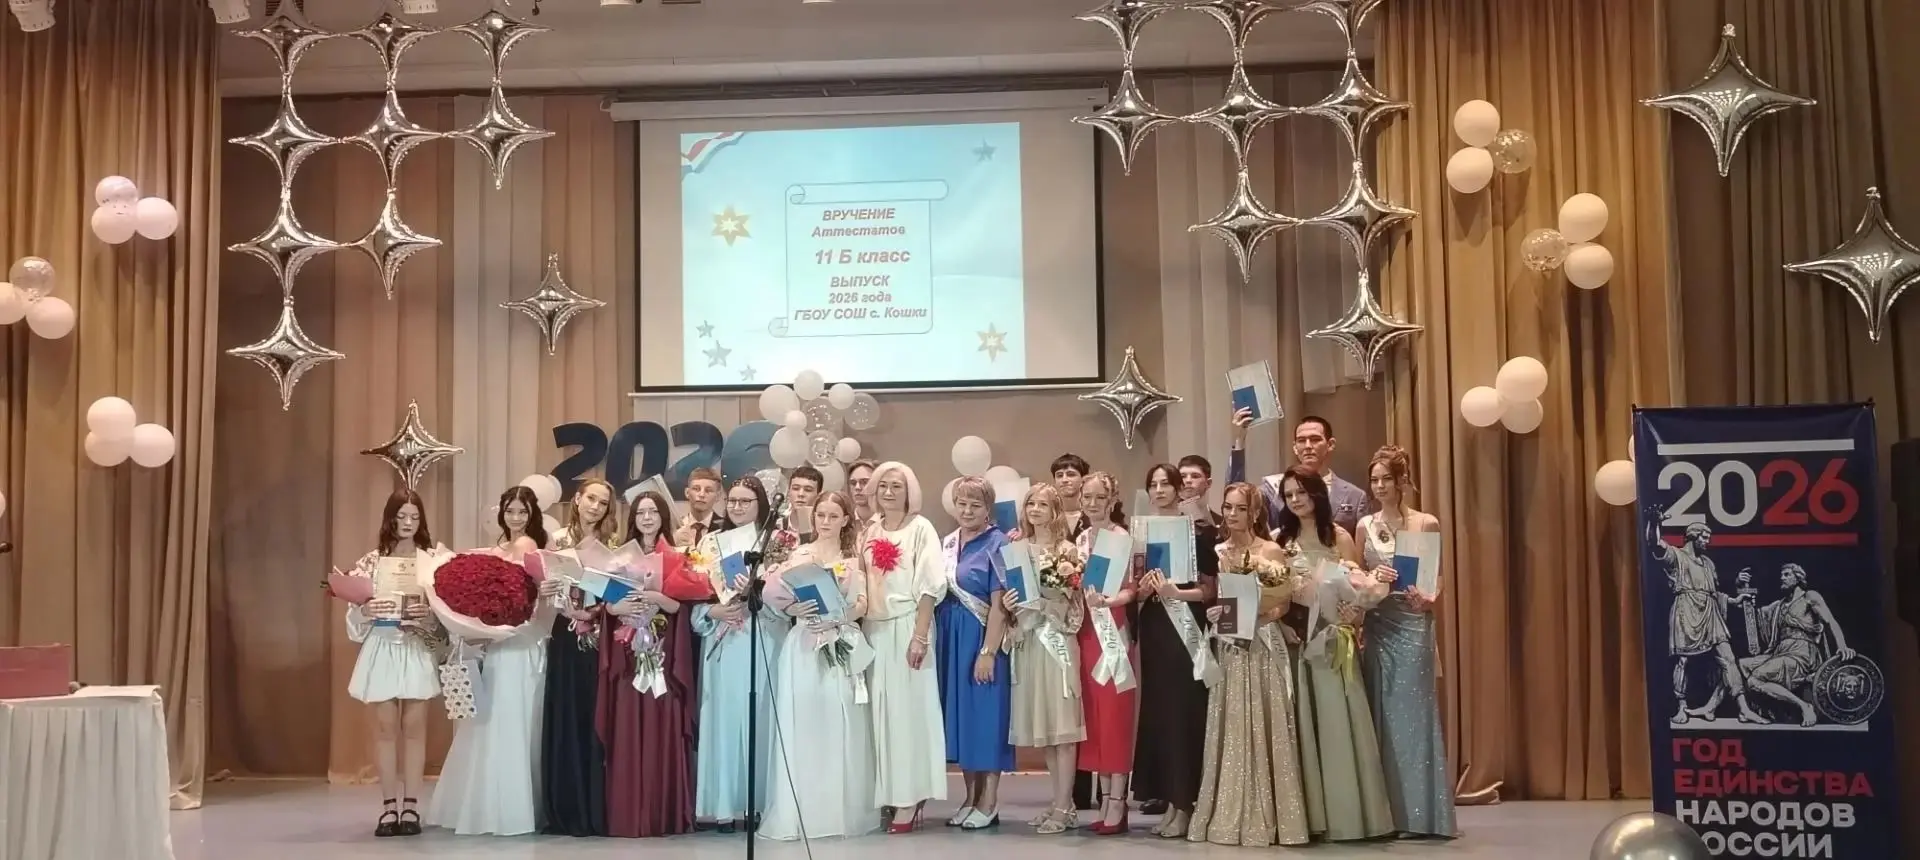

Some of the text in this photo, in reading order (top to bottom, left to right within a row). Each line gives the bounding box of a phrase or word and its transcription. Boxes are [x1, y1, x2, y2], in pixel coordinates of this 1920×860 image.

[822, 208, 896, 222] ВРУЧЕНИЕ
[811, 225, 906, 238] Аттестатов
[815, 249, 911, 265] 11 Б класс
[830, 275, 891, 288] ВЫПУСК
[828, 291, 892, 304] 2026 года
[794, 307, 928, 321] ГБОУ СОШ с. Кошки
[1657, 458, 1860, 527] 2026
[1672, 737, 1747, 767] ГОД
[1674, 769, 1874, 798] ЕДИНСТВА
[1675, 799, 1856, 830] НАРОДОВ
[1701, 831, 1833, 858] ОССИИ
